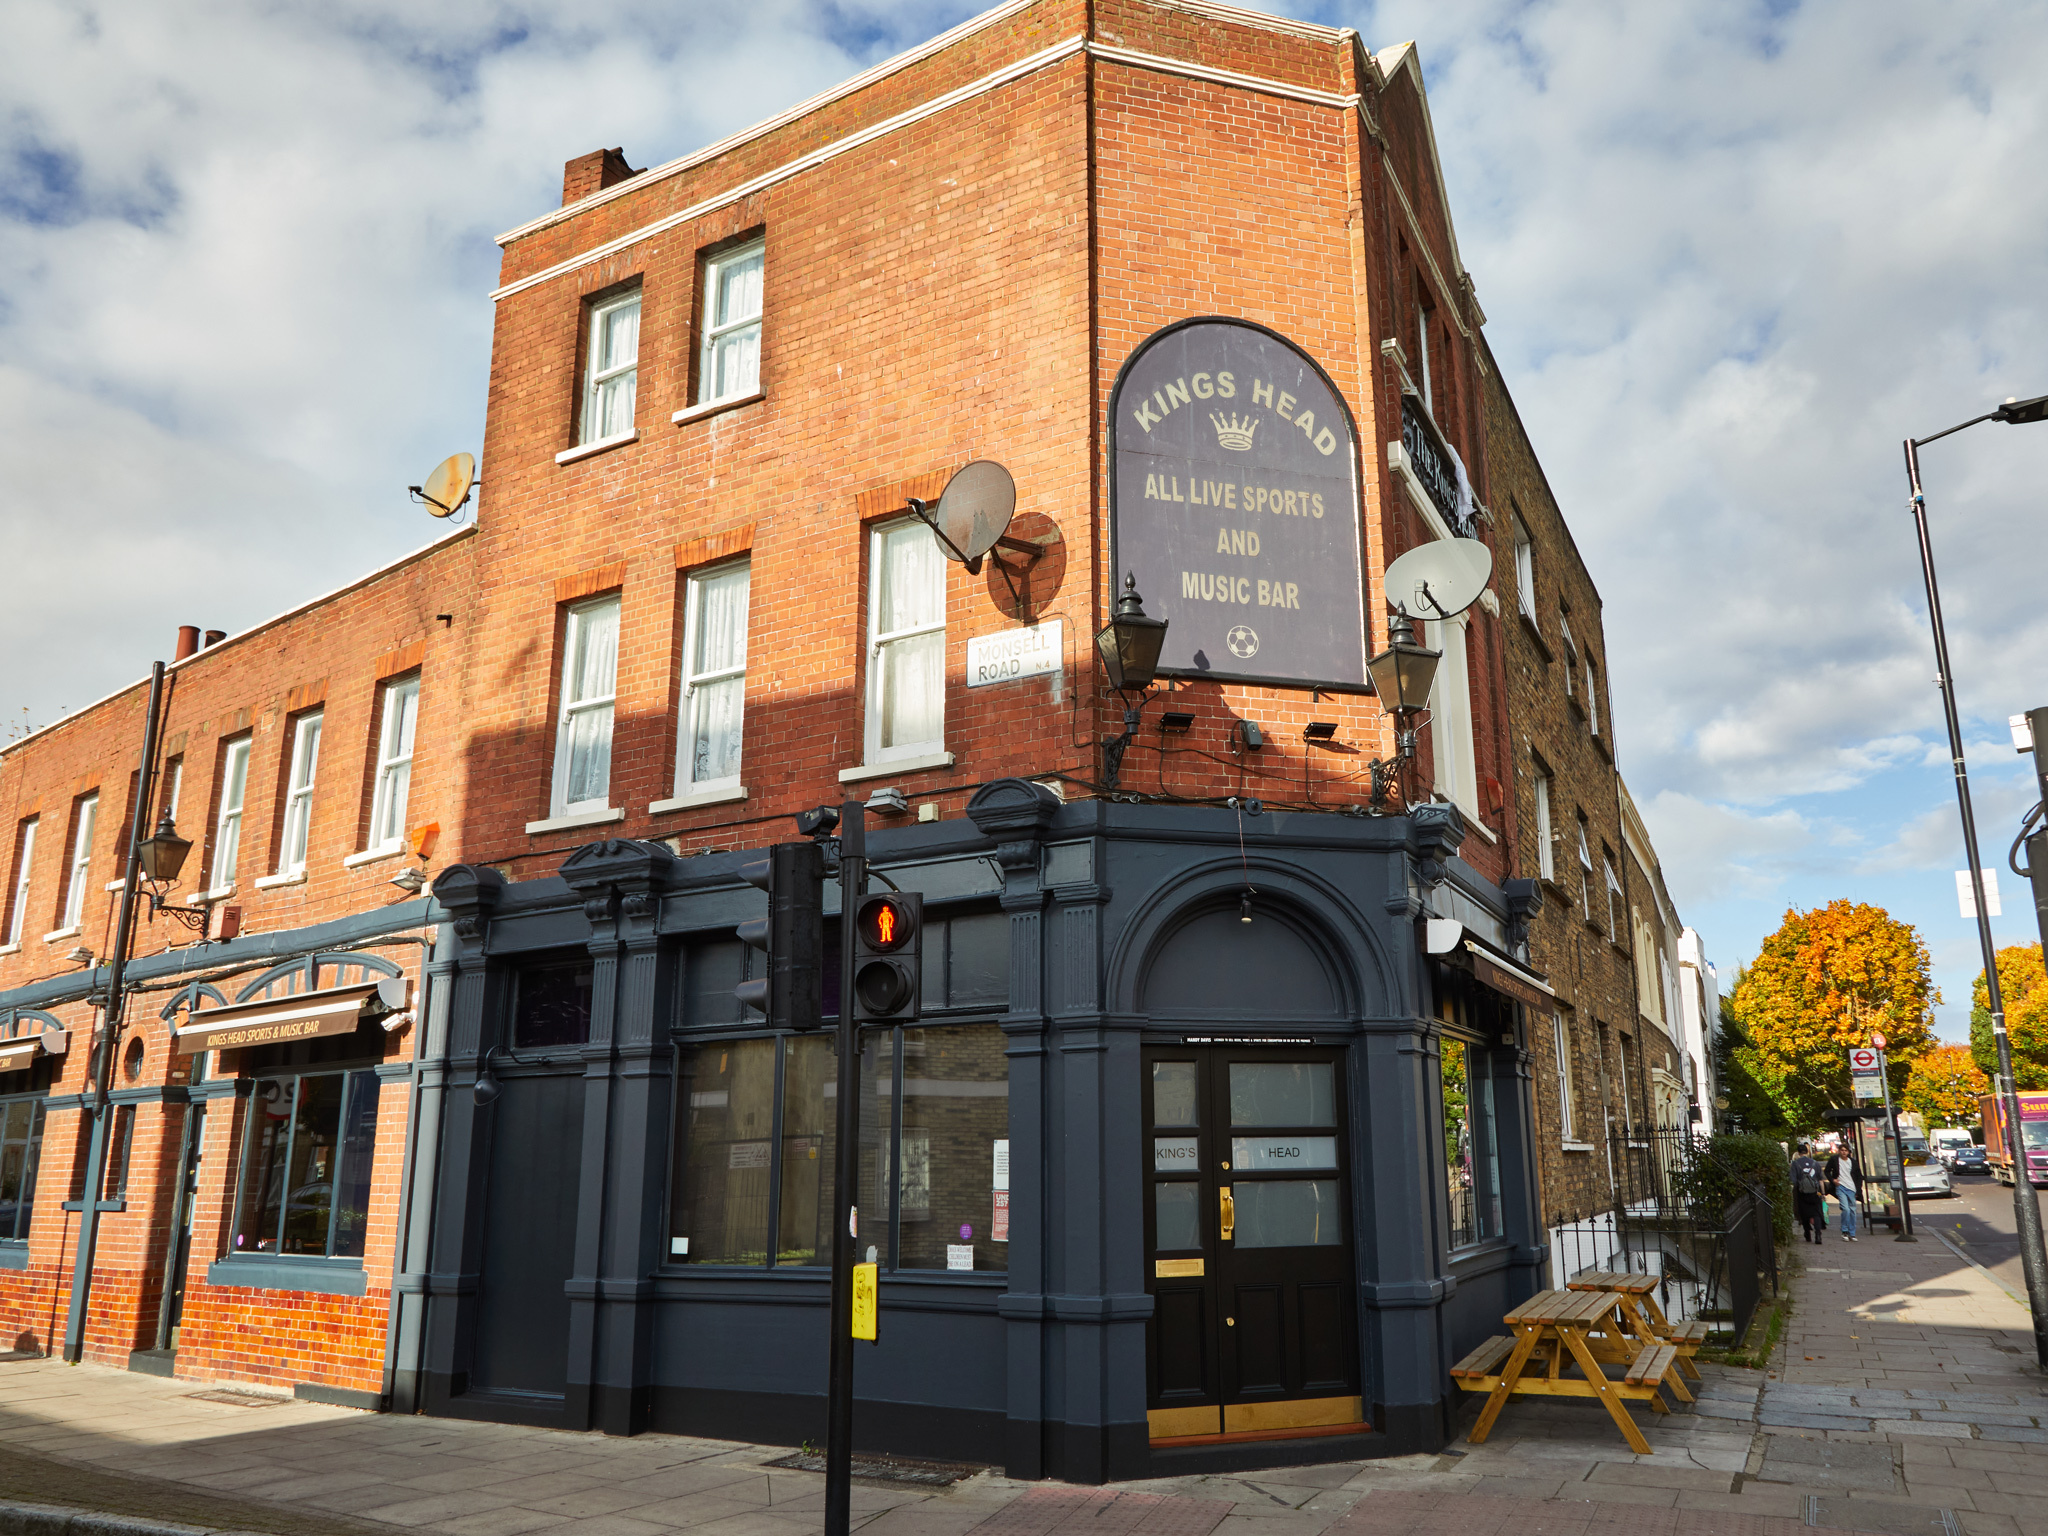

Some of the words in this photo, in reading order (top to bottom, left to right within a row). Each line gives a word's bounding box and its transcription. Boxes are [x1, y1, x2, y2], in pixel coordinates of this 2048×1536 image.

[1133, 371, 1236, 434] KINGS
[1251, 378, 1337, 456] HEAD
[1144, 473, 1184, 502] ALL
[1190, 477, 1237, 509] LIVE
[1243, 486, 1324, 519] SPORTS
[1217, 528, 1261, 557] AND
[1182, 571, 1251, 605] MUSIC
[1257, 579, 1300, 610] BAR
[978, 634, 1050, 663] MONSELL
[978, 659, 1020, 682] ROAD
[1036, 660, 1051, 670] N.4
[206, 1033, 227, 1047] KINGS
[227, 1030, 246, 1044] HEAD
[246, 1026, 273, 1042] SPORTS
[272, 1026, 279, 1039] &
[279, 1022, 304, 1038] MUSIC
[304, 1020, 320, 1035] BAR
[1156, 1148, 1196, 1159] KING'S
[1268, 1147, 1300, 1158] HEAD
